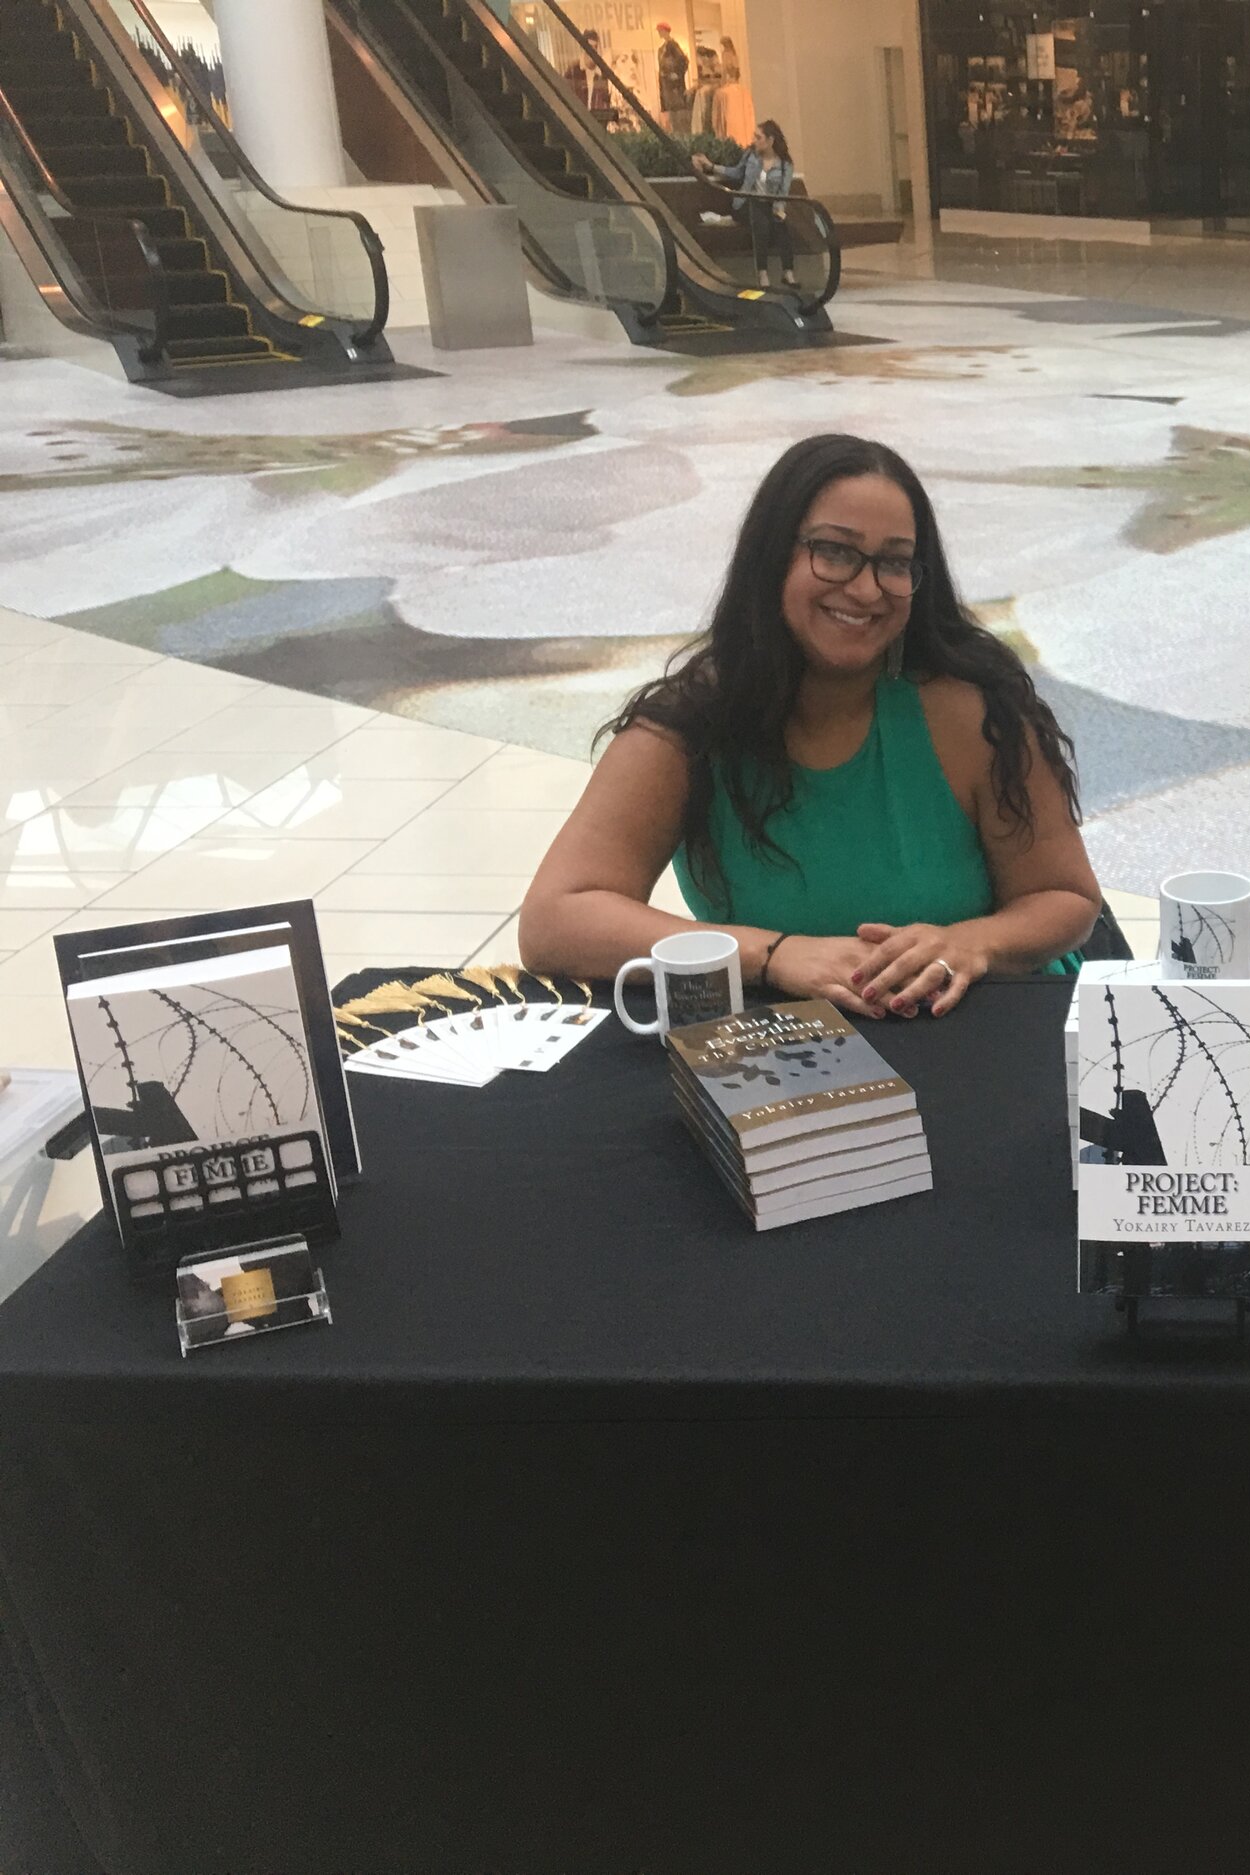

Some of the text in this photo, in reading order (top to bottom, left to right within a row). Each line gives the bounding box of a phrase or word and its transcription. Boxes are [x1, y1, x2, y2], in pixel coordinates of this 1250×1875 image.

[704, 1019, 825, 1050] Everything
[717, 1018, 770, 1033] This
[698, 1050, 736, 1063] The
[1125, 1172, 1240, 1198] PROJECT:
[1136, 1195, 1230, 1215] FEMME
